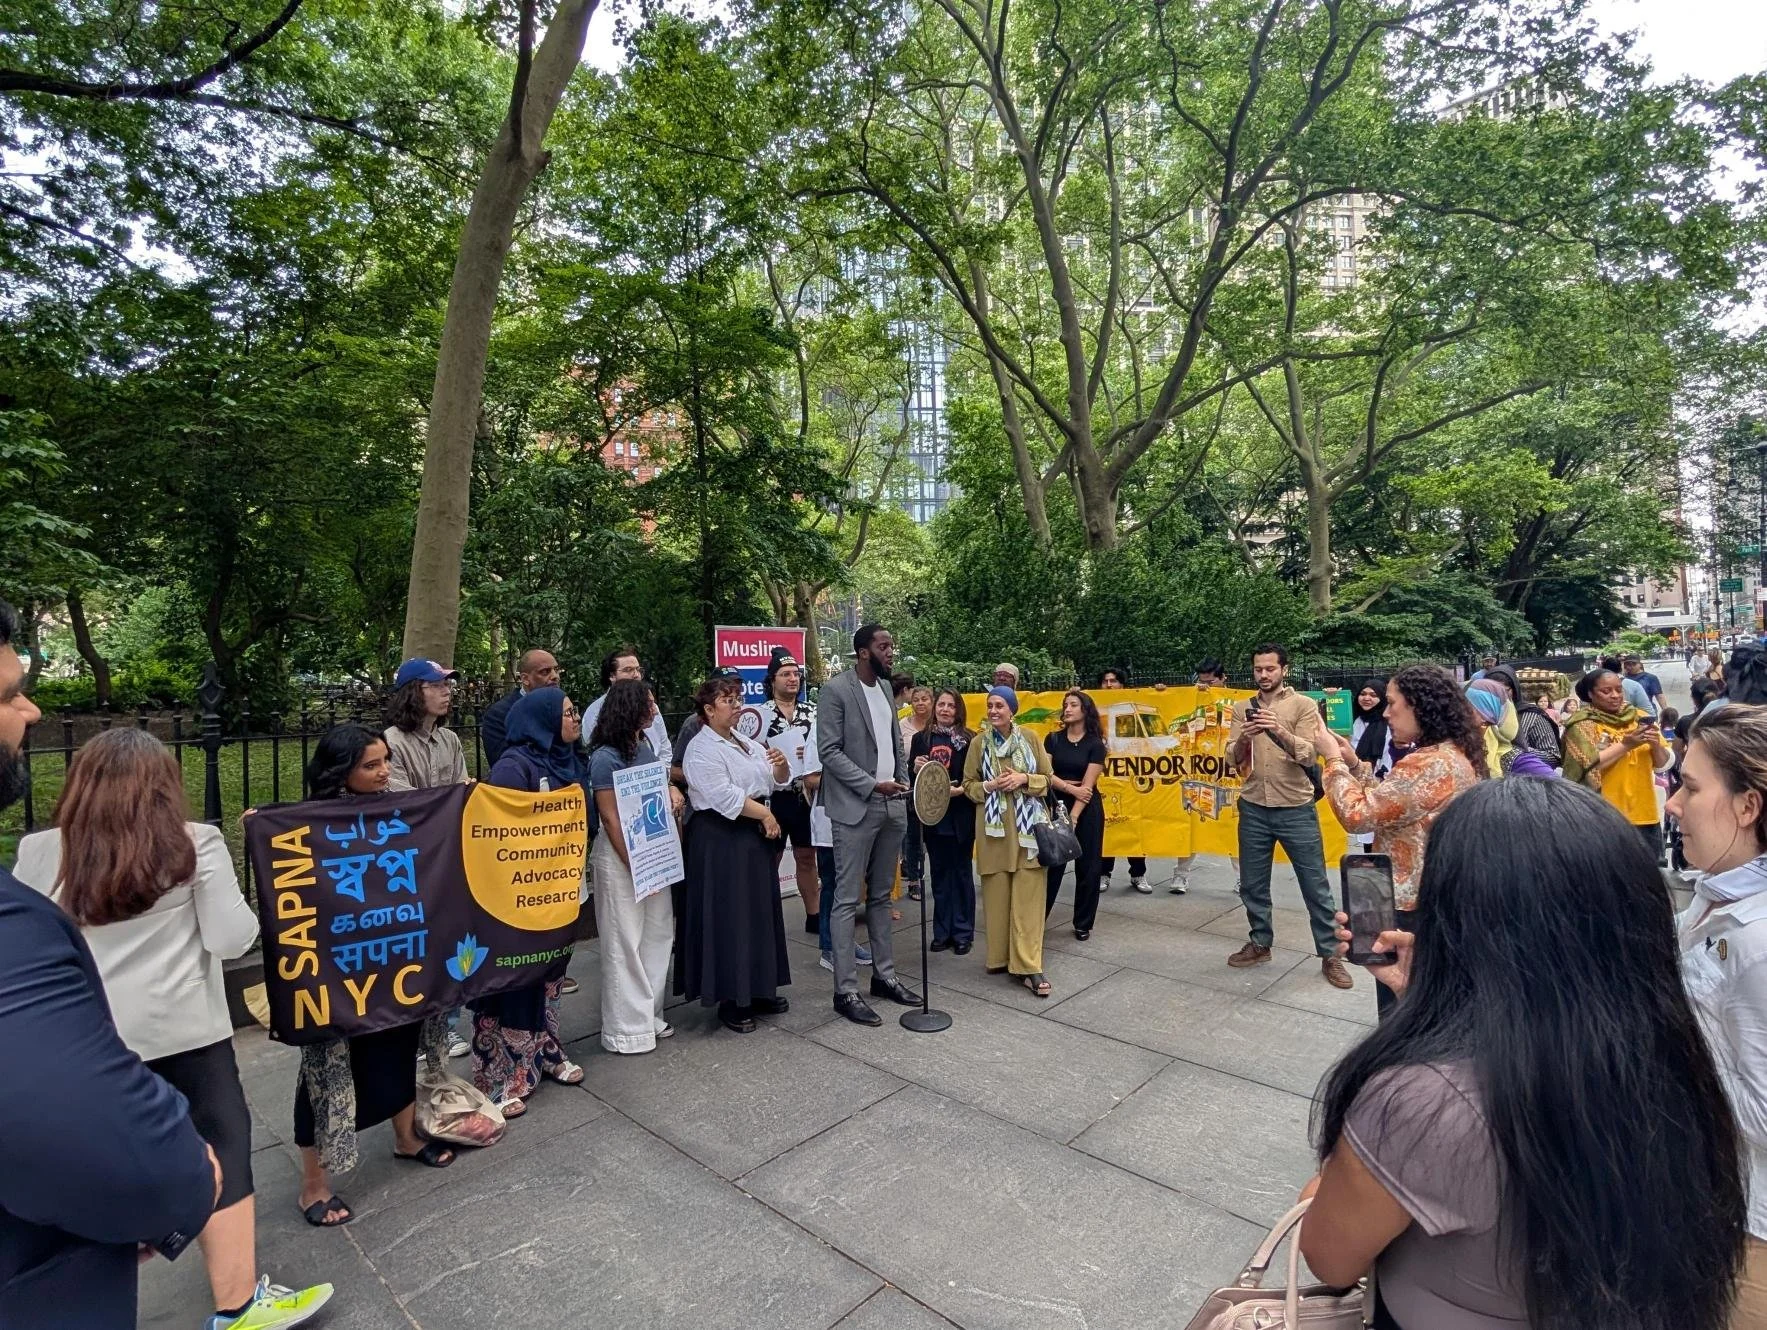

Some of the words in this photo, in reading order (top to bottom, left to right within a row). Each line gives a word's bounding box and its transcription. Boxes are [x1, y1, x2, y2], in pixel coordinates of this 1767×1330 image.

[740, 680, 764, 695] ote
[634, 770, 644, 780] THE
[643, 766, 665, 778] SILENCE
[1104, 755, 1187, 777] VENDOR
[630, 784, 641, 794] THE
[533, 797, 582, 814] Health
[324, 808, 411, 850] خواب
[471, 819, 585, 842] Empowerment
[496, 842, 585, 862] Community
[321, 847, 419, 903] স্বপ্ন
[511, 866, 584, 885] Advocacy
[271, 825, 320, 982] SAPNA
[330, 929, 428, 974] सपना
